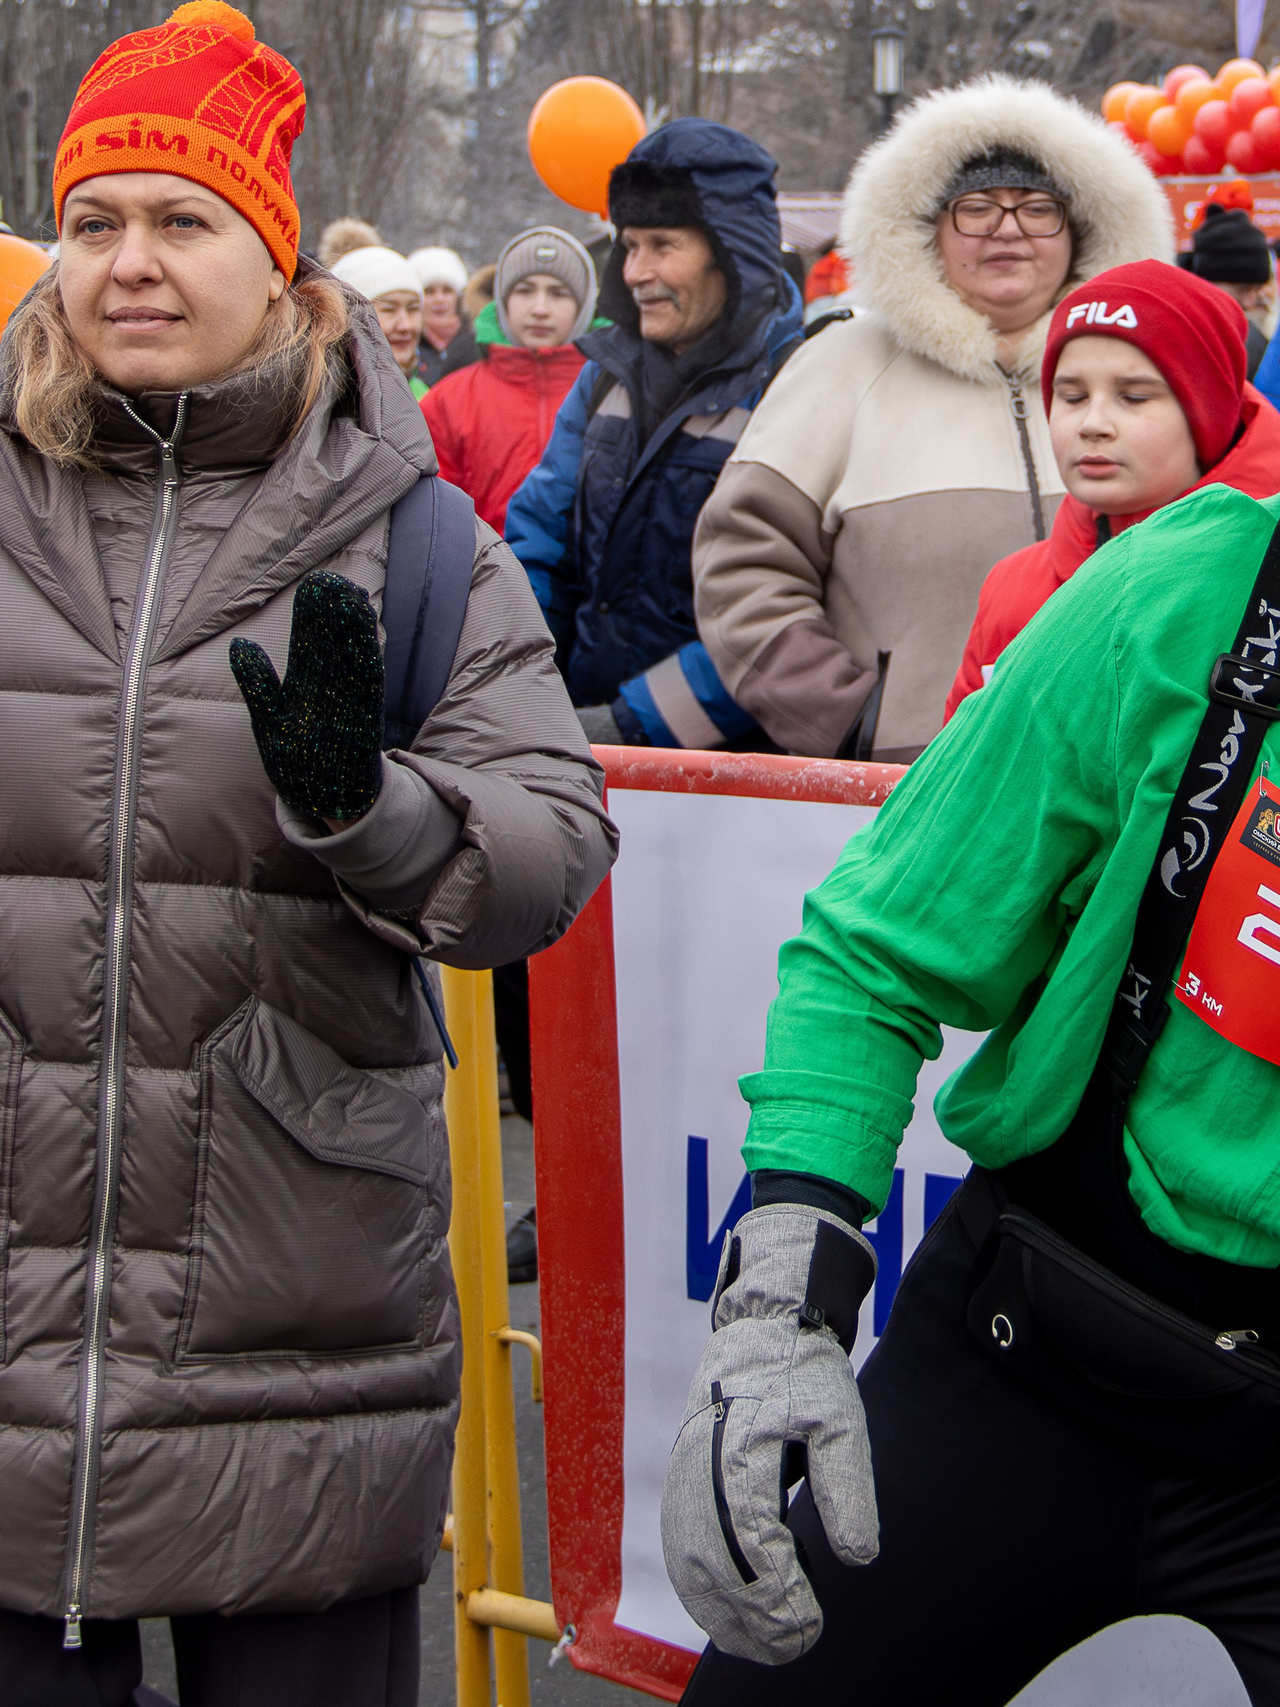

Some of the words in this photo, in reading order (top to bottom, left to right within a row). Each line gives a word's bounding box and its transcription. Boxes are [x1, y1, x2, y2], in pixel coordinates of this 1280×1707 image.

[1066, 302, 1138, 329] FILA
[1252, 829, 1278, 848] ОМСКИЙ
[1185, 971, 1201, 996] 3
[1201, 991, 1223, 1017] КМ
